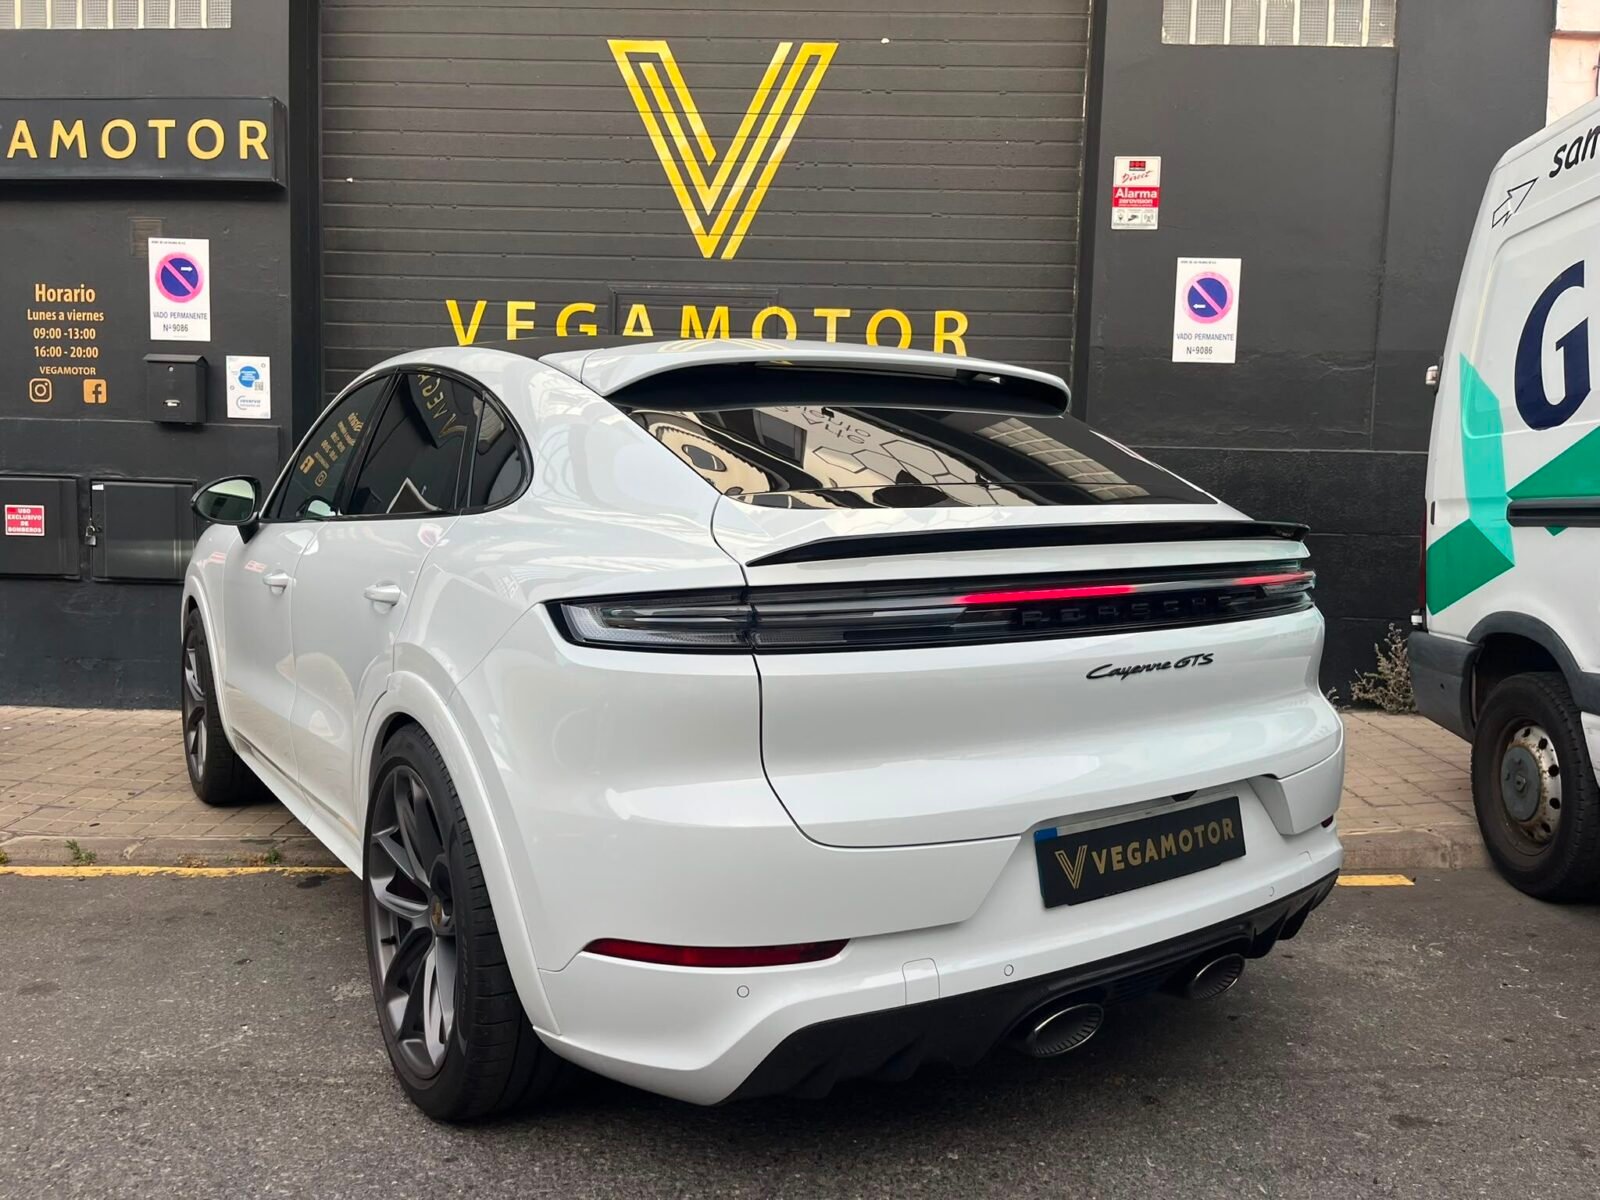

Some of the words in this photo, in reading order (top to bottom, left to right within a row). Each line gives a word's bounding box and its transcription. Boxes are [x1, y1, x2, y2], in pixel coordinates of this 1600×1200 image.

[1115, 187, 1158, 199] Alarma
[35, 283, 96, 302] Horario
[27, 308, 57, 320] Lunes
[58, 311, 65, 320] a
[67, 309, 104, 321] viernes
[153, 311, 168, 319] VADO
[170, 312, 207, 320] PERMANENTE
[33, 327, 61, 339] 09:00
[1176, 333, 1193, 341] VADO
[1195, 333, 1235, 341] PERMANENTE
[1514, 260, 1591, 431] G
[34, 346, 62, 357] 16:00
[70, 346, 99, 358] 20:00
[39, 366, 97, 376] VEGAMOTOR
[1086, 663, 1172, 680] Cayenne
[1174, 653, 1214, 669] GTS
[1091, 818, 1235, 874] VEGAMOTOR
